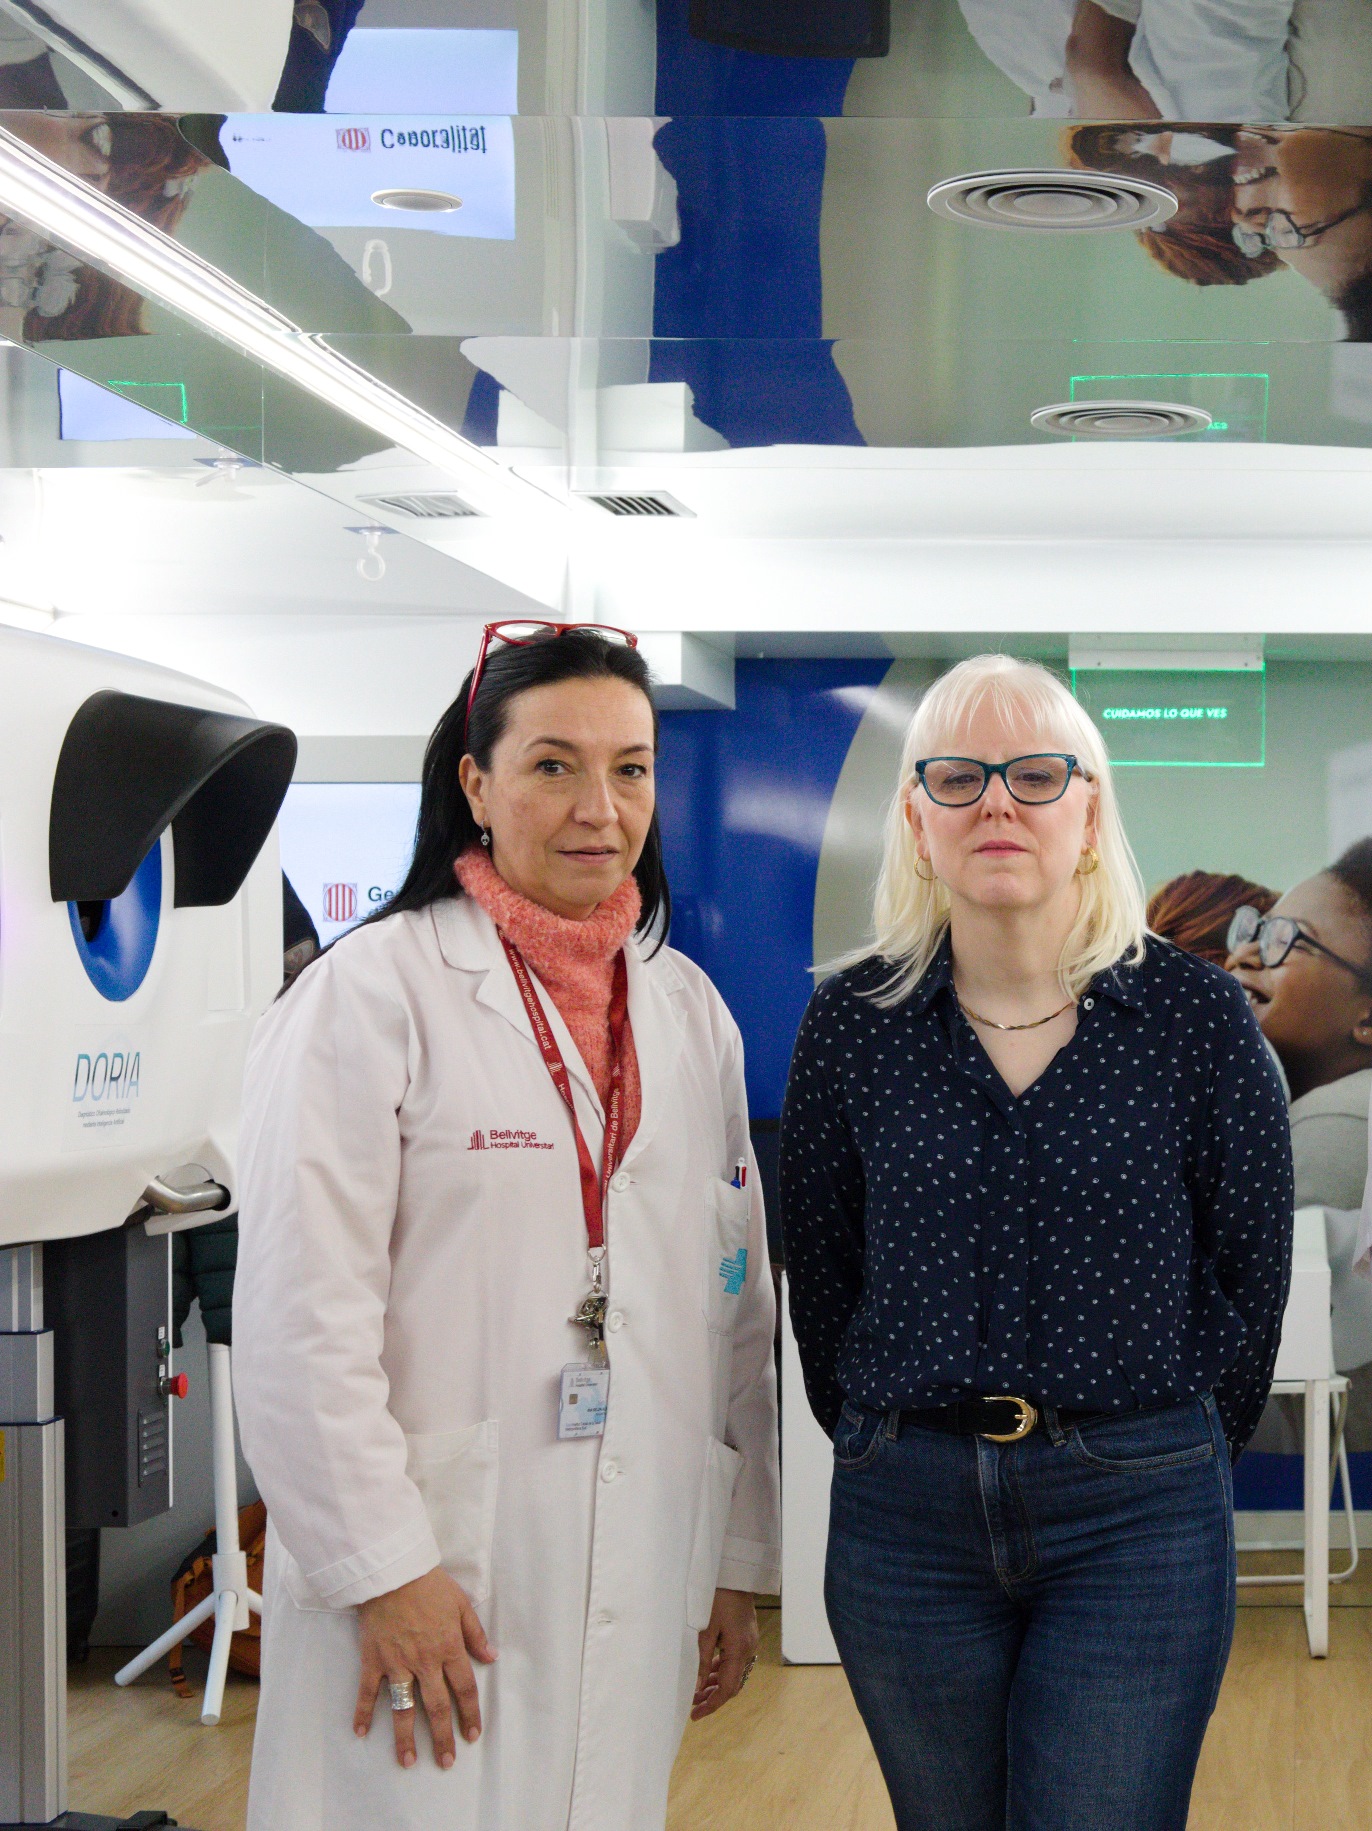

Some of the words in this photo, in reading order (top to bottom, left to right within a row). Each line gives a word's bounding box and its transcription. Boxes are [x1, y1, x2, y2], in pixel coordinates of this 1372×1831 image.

[1102, 707, 1162, 719] CUIDAMOS
[1163, 707, 1179, 719] LO
[1180, 707, 1204, 719] QUE
[1206, 707, 1228, 719] VES
[72, 1051, 140, 1102] DORIA
[489, 1129, 537, 1141] Bellvitge
[490, 1141, 520, 1150] Hospital
[521, 1141, 555, 1150] Universitari
